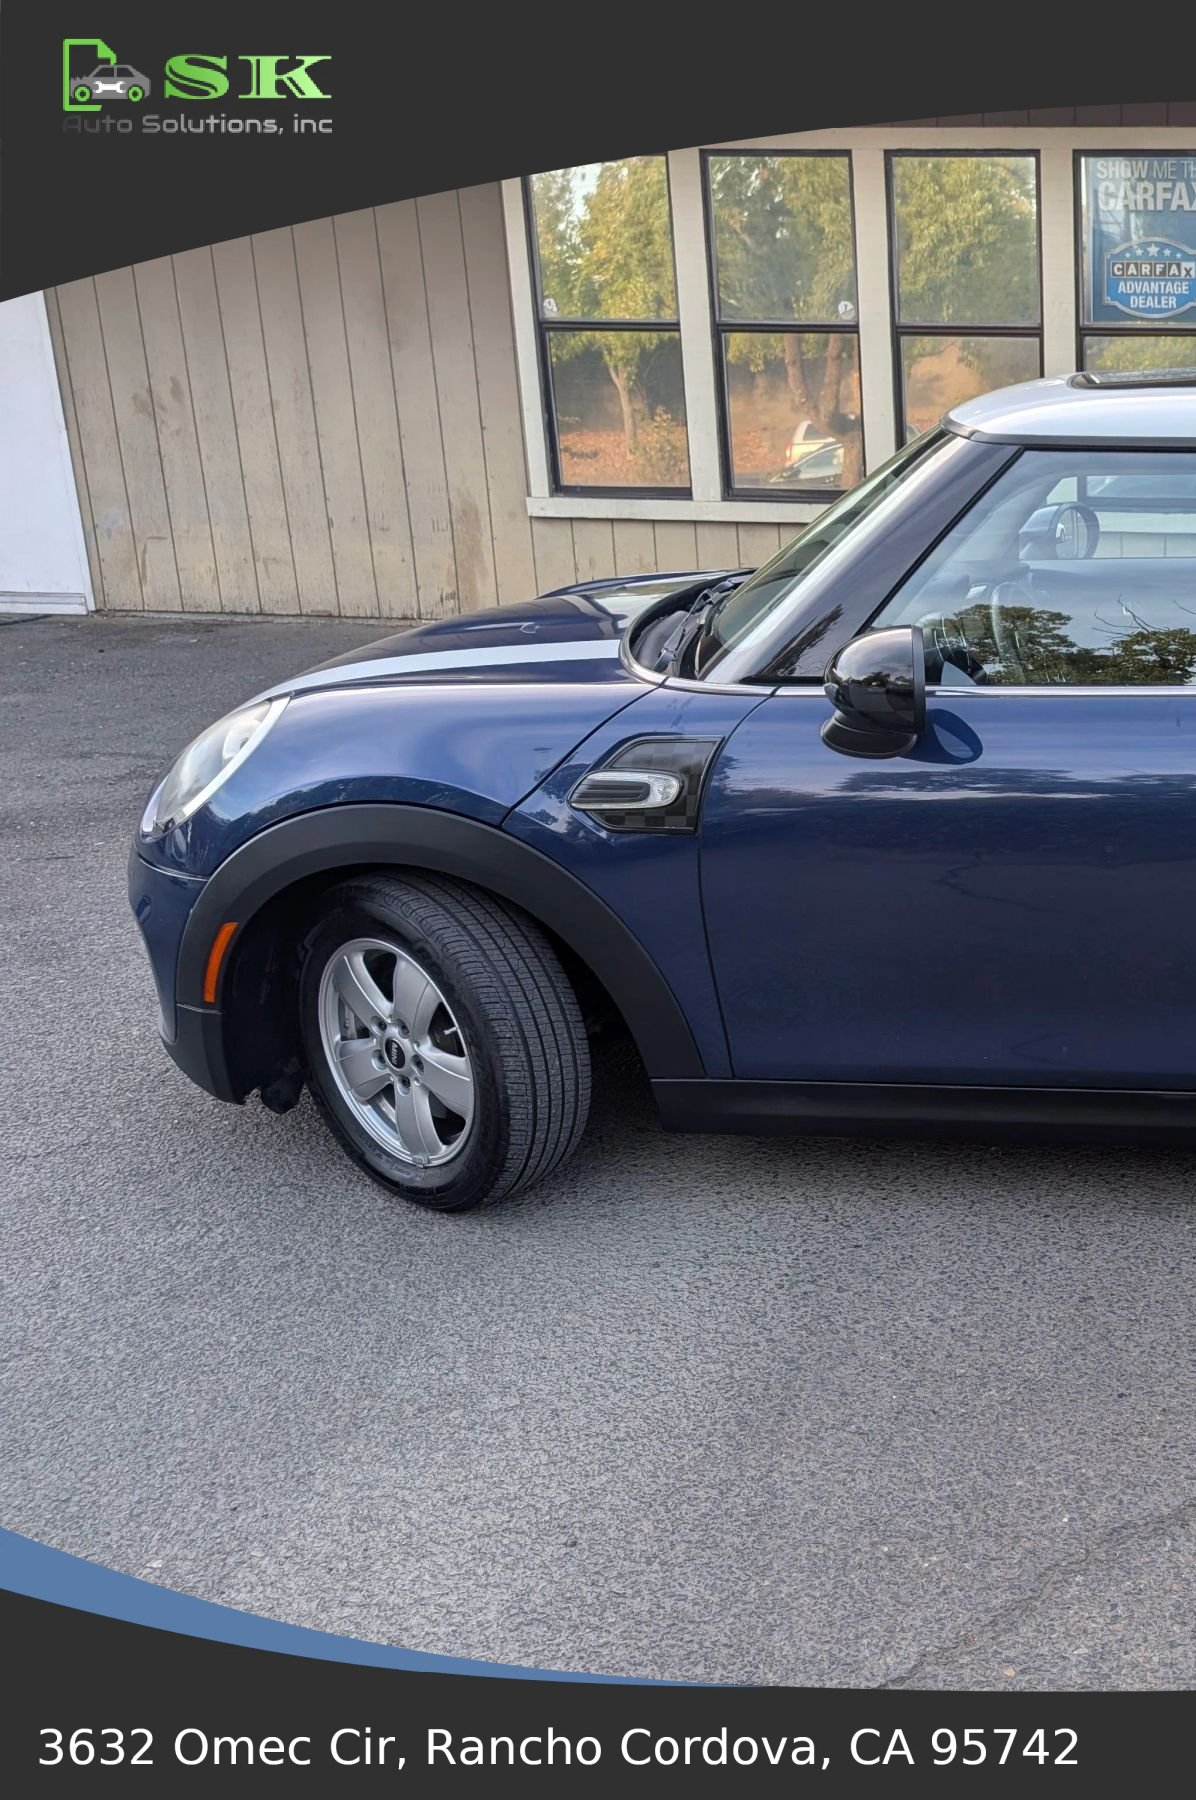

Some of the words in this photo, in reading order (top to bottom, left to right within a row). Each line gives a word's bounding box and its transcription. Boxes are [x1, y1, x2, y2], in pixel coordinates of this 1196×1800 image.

[1097, 160, 1148, 178] SHOW
[1153, 161, 1176, 179] ME
[1113, 263, 1194, 277] CARFAX
[1118, 281, 1189, 294] ADVANTAGE
[1130, 296, 1177, 309] DEALER
